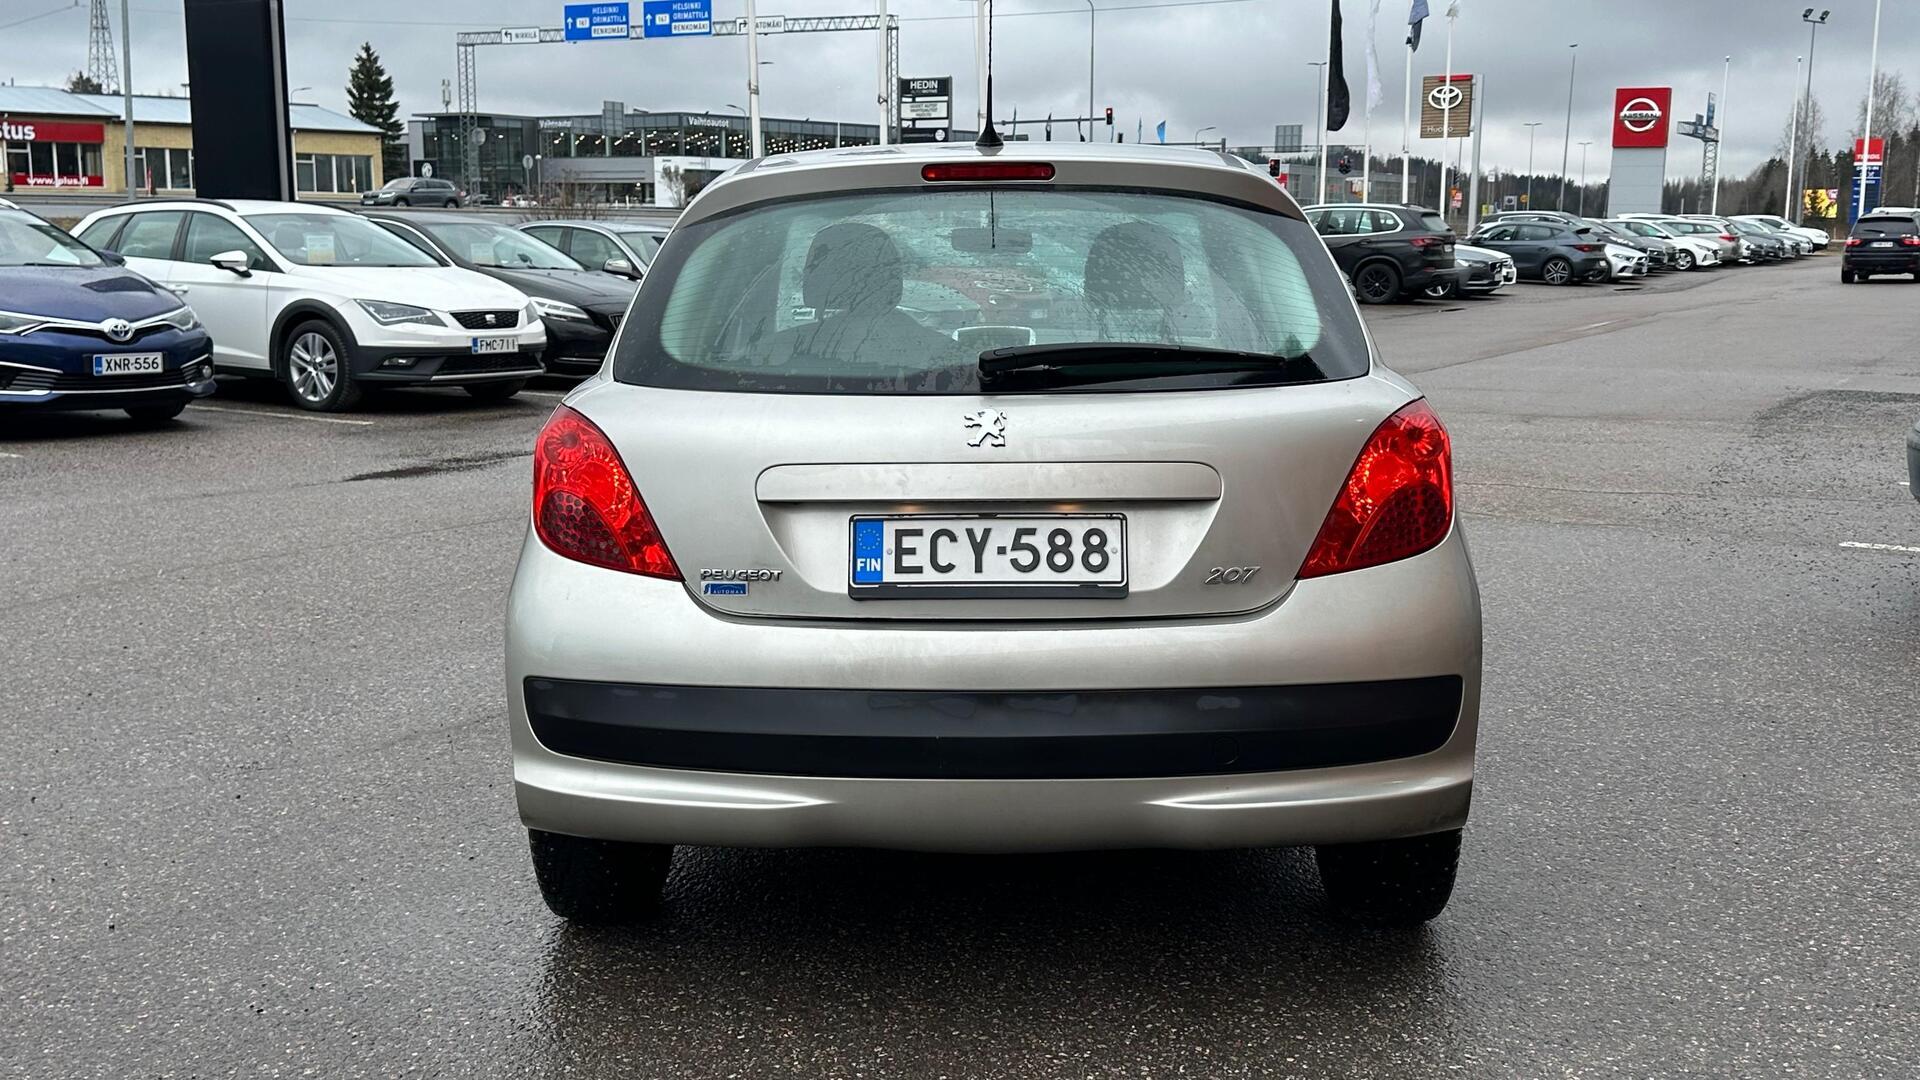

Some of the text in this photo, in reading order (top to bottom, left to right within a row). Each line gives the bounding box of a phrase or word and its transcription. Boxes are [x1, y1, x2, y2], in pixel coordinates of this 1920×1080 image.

[592, 6, 619, 14] HELSINKI
[672, 2, 701, 10] HELSINKI
[592, 14, 627, 24] ORIMATTILA
[672, 11, 709, 20] ORIMATTILA
[673, 22, 708, 32] RENKOMÄKI
[755, 20, 782, 29] ATOMÄKI
[910, 80, 938, 90] HEDIN
[688, 116, 729, 128] Vaihtoautot
[0, 121, 36, 140] tus
[480, 339, 515, 351] FMC-711
[105, 357, 159, 372] XNR-556
[893, 527, 1110, 575] ECY-588
[856, 557, 881, 573] FIN
[700, 568, 783, 582] PEUGEOT
[1204, 566, 1261, 585] 207
